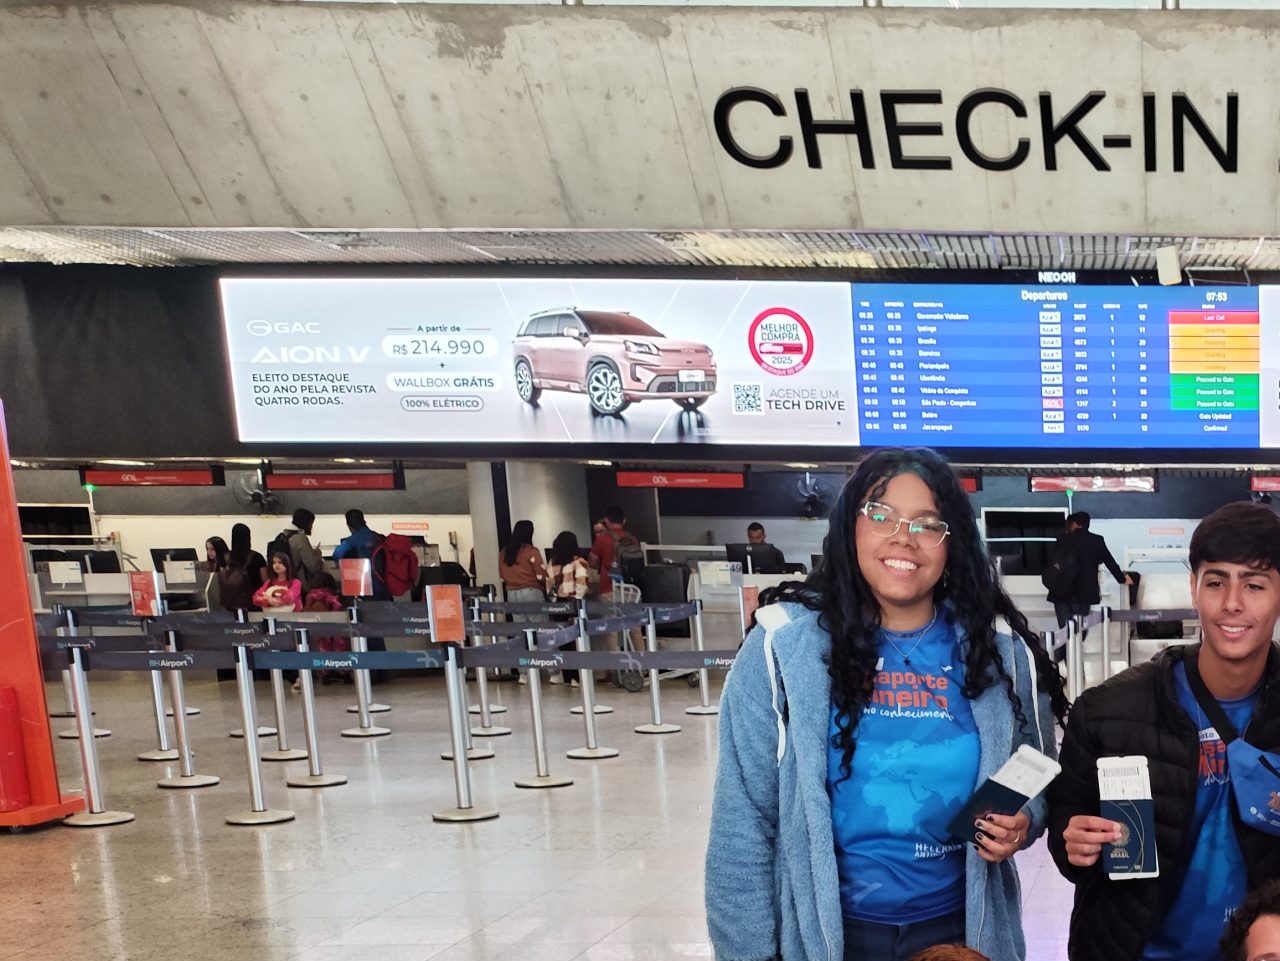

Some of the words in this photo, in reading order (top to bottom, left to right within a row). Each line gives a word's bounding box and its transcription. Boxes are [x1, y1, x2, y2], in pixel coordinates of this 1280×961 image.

[713, 85, 1239, 173] CHECK-IN
[1038, 272, 1076, 283] NEOOH
[1021, 290, 1068, 303] Departures
[273, 322, 320, 334] GAC
[426, 325, 448, 333] partir
[760, 323, 798, 333] MELHOR
[761, 332, 800, 341] COMPRA
[392, 344, 408, 356] R$
[411, 339, 485, 355] 214.990
[250, 345, 340, 364] AION
[347, 346, 371, 363] V
[771, 356, 793, 364] 2025
[252, 373, 289, 382] ELEITO
[292, 373, 350, 383] DESTAQUE
[394, 377, 450, 388] WALLBOX
[453, 375, 495, 388] GRÁTIS
[253, 385, 270, 393] DO
[273, 385, 297, 393] ANO
[300, 385, 329, 393] PELA
[332, 385, 377, 393] REVISTA
[769, 388, 817, 399] AGENDE
[820, 389, 839, 399] UM
[254, 396, 299, 406] QUATRO
[302, 396, 343, 405] RODAS.
[405, 399, 430, 408] 100%
[432, 398, 480, 408] ELÉTRICO
[766, 400, 801, 410] TECH
[805, 400, 845, 411] DRIVE
